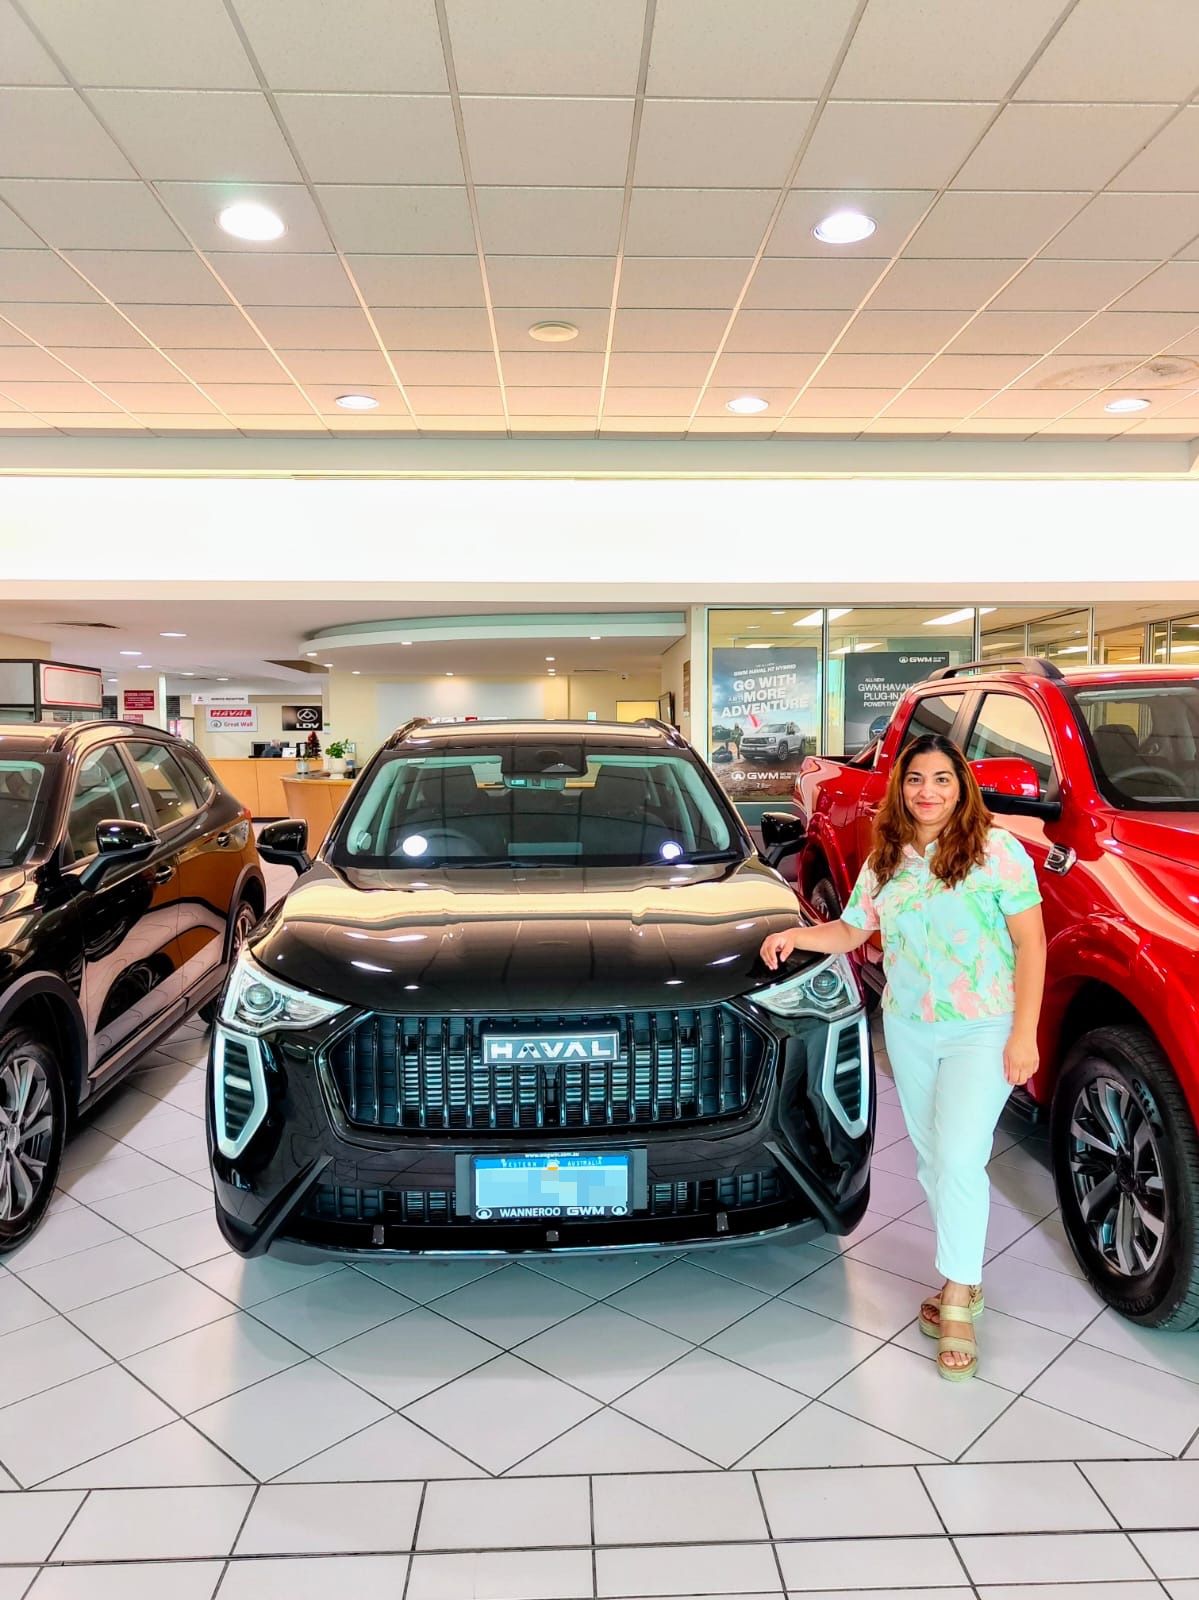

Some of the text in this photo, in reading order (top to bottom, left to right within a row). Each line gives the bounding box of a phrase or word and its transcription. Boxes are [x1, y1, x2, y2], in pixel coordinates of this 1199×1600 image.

[733, 673, 797, 692] GO WITH
[857, 683, 882, 691] GWM
[743, 687, 786, 703] MORE
[863, 692, 899, 700] PLUG-IN
[721, 698, 809, 718] ADVENTURE
[747, 772, 779, 780] GWM
[490, 1040, 611, 1059] HAVAL
[1132, 1078, 1155, 1119] Giti
[499, 1206, 605, 1217] WANNEROO GWM
